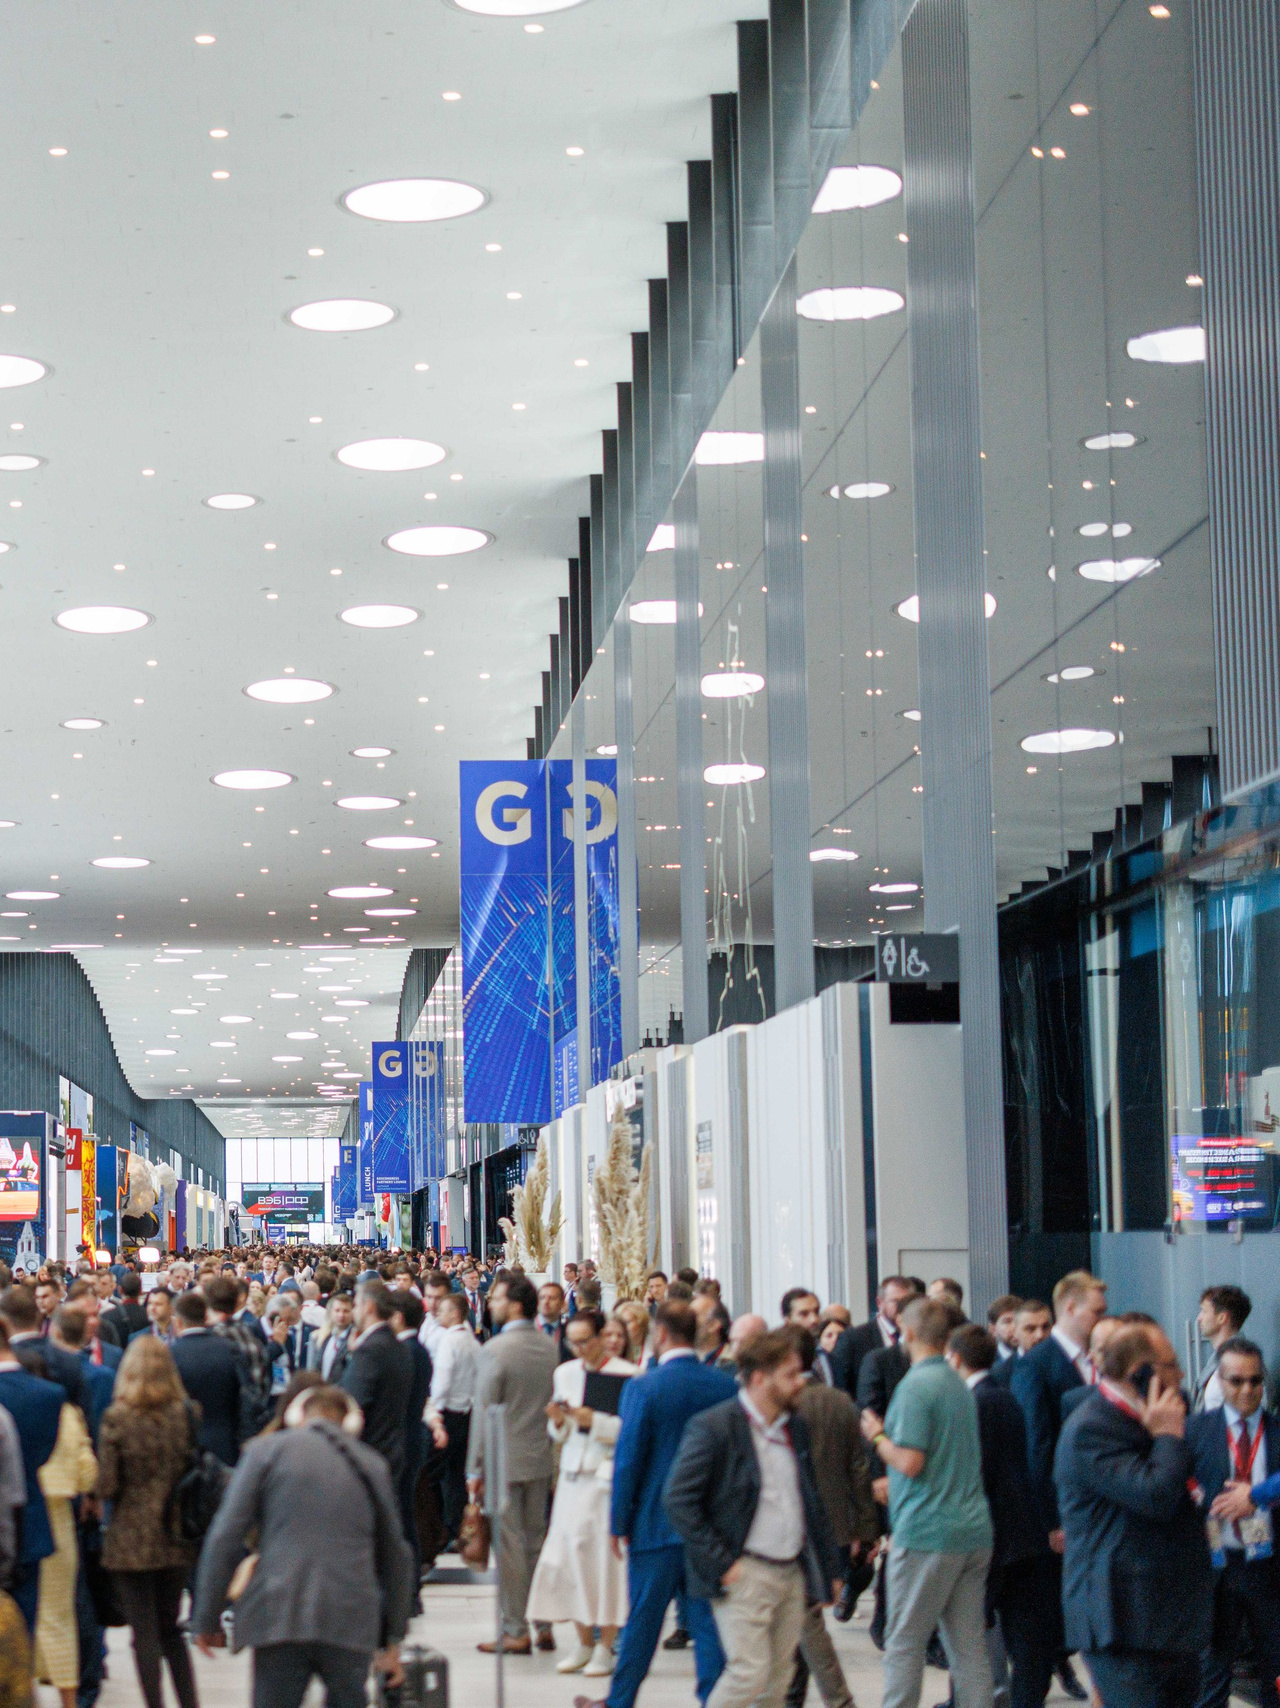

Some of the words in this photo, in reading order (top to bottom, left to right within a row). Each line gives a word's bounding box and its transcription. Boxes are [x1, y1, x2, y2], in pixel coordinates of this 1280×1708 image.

[474, 780, 532, 846] G
[378, 1049, 403, 1078] G
[343, 1149, 352, 1164] E
[364, 1166, 372, 1192] LUNCH
